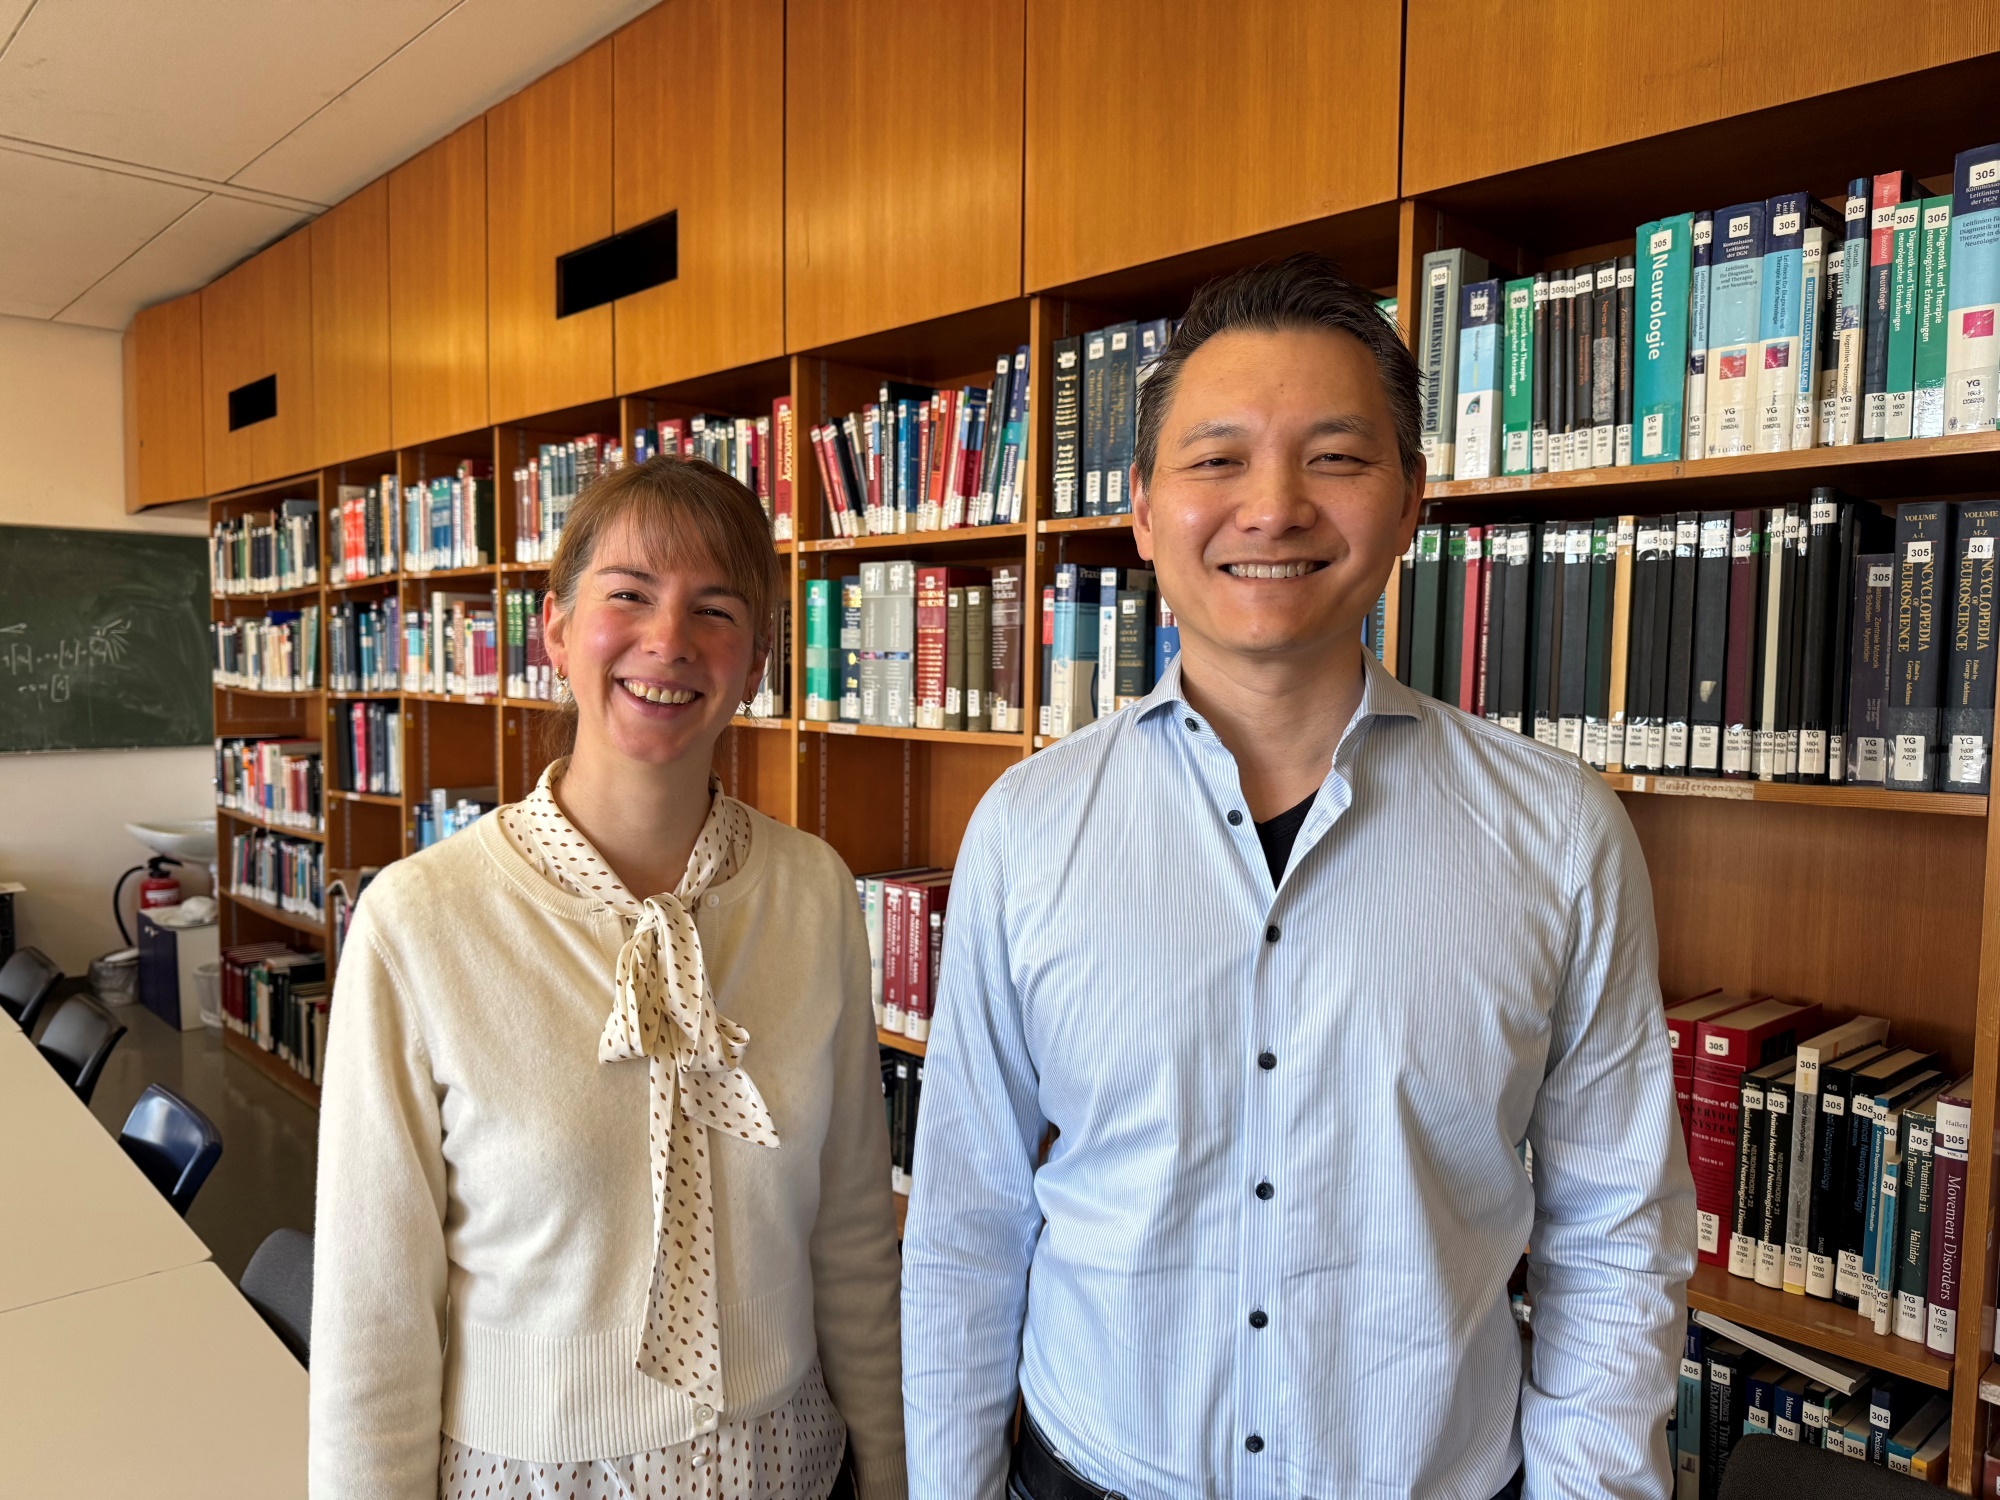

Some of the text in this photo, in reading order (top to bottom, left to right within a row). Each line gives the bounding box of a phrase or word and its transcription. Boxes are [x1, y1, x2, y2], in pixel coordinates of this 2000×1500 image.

[1975, 169, 1995, 180] 305
[1970, 190, 2000, 198] Leitlinien
[1983, 196, 1998, 204] DGN
[1896, 214, 1915, 224] 305
[1928, 213, 1947, 223] 305
[1732, 222, 1749, 232] 305
[1779, 220, 1796, 230] 305
[1959, 225, 1990, 235] Diagnostik
[1722, 238, 1753, 248] Kommission
[1960, 233, 1985, 242] Therapie
[1965, 238, 1999, 247] Neurologie
[1726, 244, 1750, 252] Leitlinien
[1907, 230, 1916, 268] Diagnostik
[1725, 263, 1749, 272] Leitlinien
[1728, 269, 1754, 278] Diagnostik
[1731, 274, 1753, 284] Therapie
[1893, 232, 1905, 331] neurologischer Erkrankungen
[1934, 227, 1948, 324] Diagnostik und Therapie
[1730, 279, 1758, 289] Neurologie
[1878, 270, 1888, 310] Neurologie
[1920, 230, 1935, 342] neurologischer Erkrankungen
[1904, 284, 1914, 315] Therapie
[1646, 253, 1668, 360] Neurologie
[1426, 284, 1444, 432] OMPREHENSIVE NEUROLOGY
[1842, 364, 1850, 396] Neurologie
[1964, 510, 1998, 518] VOLUME
[1911, 549, 1929, 557] 305
[1079, 568, 1100, 579] Praxi
[1873, 573, 1890, 581] 305
[1918, 553, 1934, 651] NCYCLOPEDIA
[1977, 554, 1994, 650] NCYCLOPEDIA
[1863, 628, 1871, 662] Myositiden
[1709, 1042, 1724, 1051] 305
[1800, 1062, 1817, 1070] 305
[1745, 1096, 1761, 1105] 305
[1769, 1099, 1784, 1108] 305
[1825, 1101, 1842, 1110] 305
[1692, 1106, 1738, 1122] NERVOU
[1856, 1103, 1873, 1113] 305
[1770, 1112, 1778, 1136] Animal
[1946, 1120, 1968, 1129] Hallett
[1692, 1132, 1735, 1146] THIRD EDITION
[1742, 1129, 1751, 1154] Models
[1798, 1116, 1807, 1162] Neurophysiology
[1911, 1136, 1929, 1146] 305
[1946, 1135, 1965, 1144] 305
[1768, 1137, 1777, 1163] Models
[1699, 1156, 1717, 1165] VOLUME
[1821, 1126, 1834, 1190] Neurophysiology
[1854, 1117, 1870, 1213] linical Neurophysiology
[1871, 1153, 1880, 1199] Dopplersonographie
[1905, 1156, 1917, 1188] Testing
[1738, 1164, 1748, 1208] Neurological
[1919, 1160, 1931, 1212] Potentials in
[1764, 1173, 1774, 1216] Neurological
[1940, 1174, 1961, 1300] Movement Disorders
[1907, 1229, 1920, 1265] Halliday
[1684, 1364, 1698, 1376] 305
[1712, 1370, 1728, 1380] 305
[1750, 1412, 1765, 1424] 305
[1804, 1411, 1820, 1423] 305
[1872, 1412, 1889, 1424] 305
[1778, 1424, 1794, 1436] 305
[1847, 1445, 1864, 1456] 305
[1873, 1431, 1883, 1459] Decision
